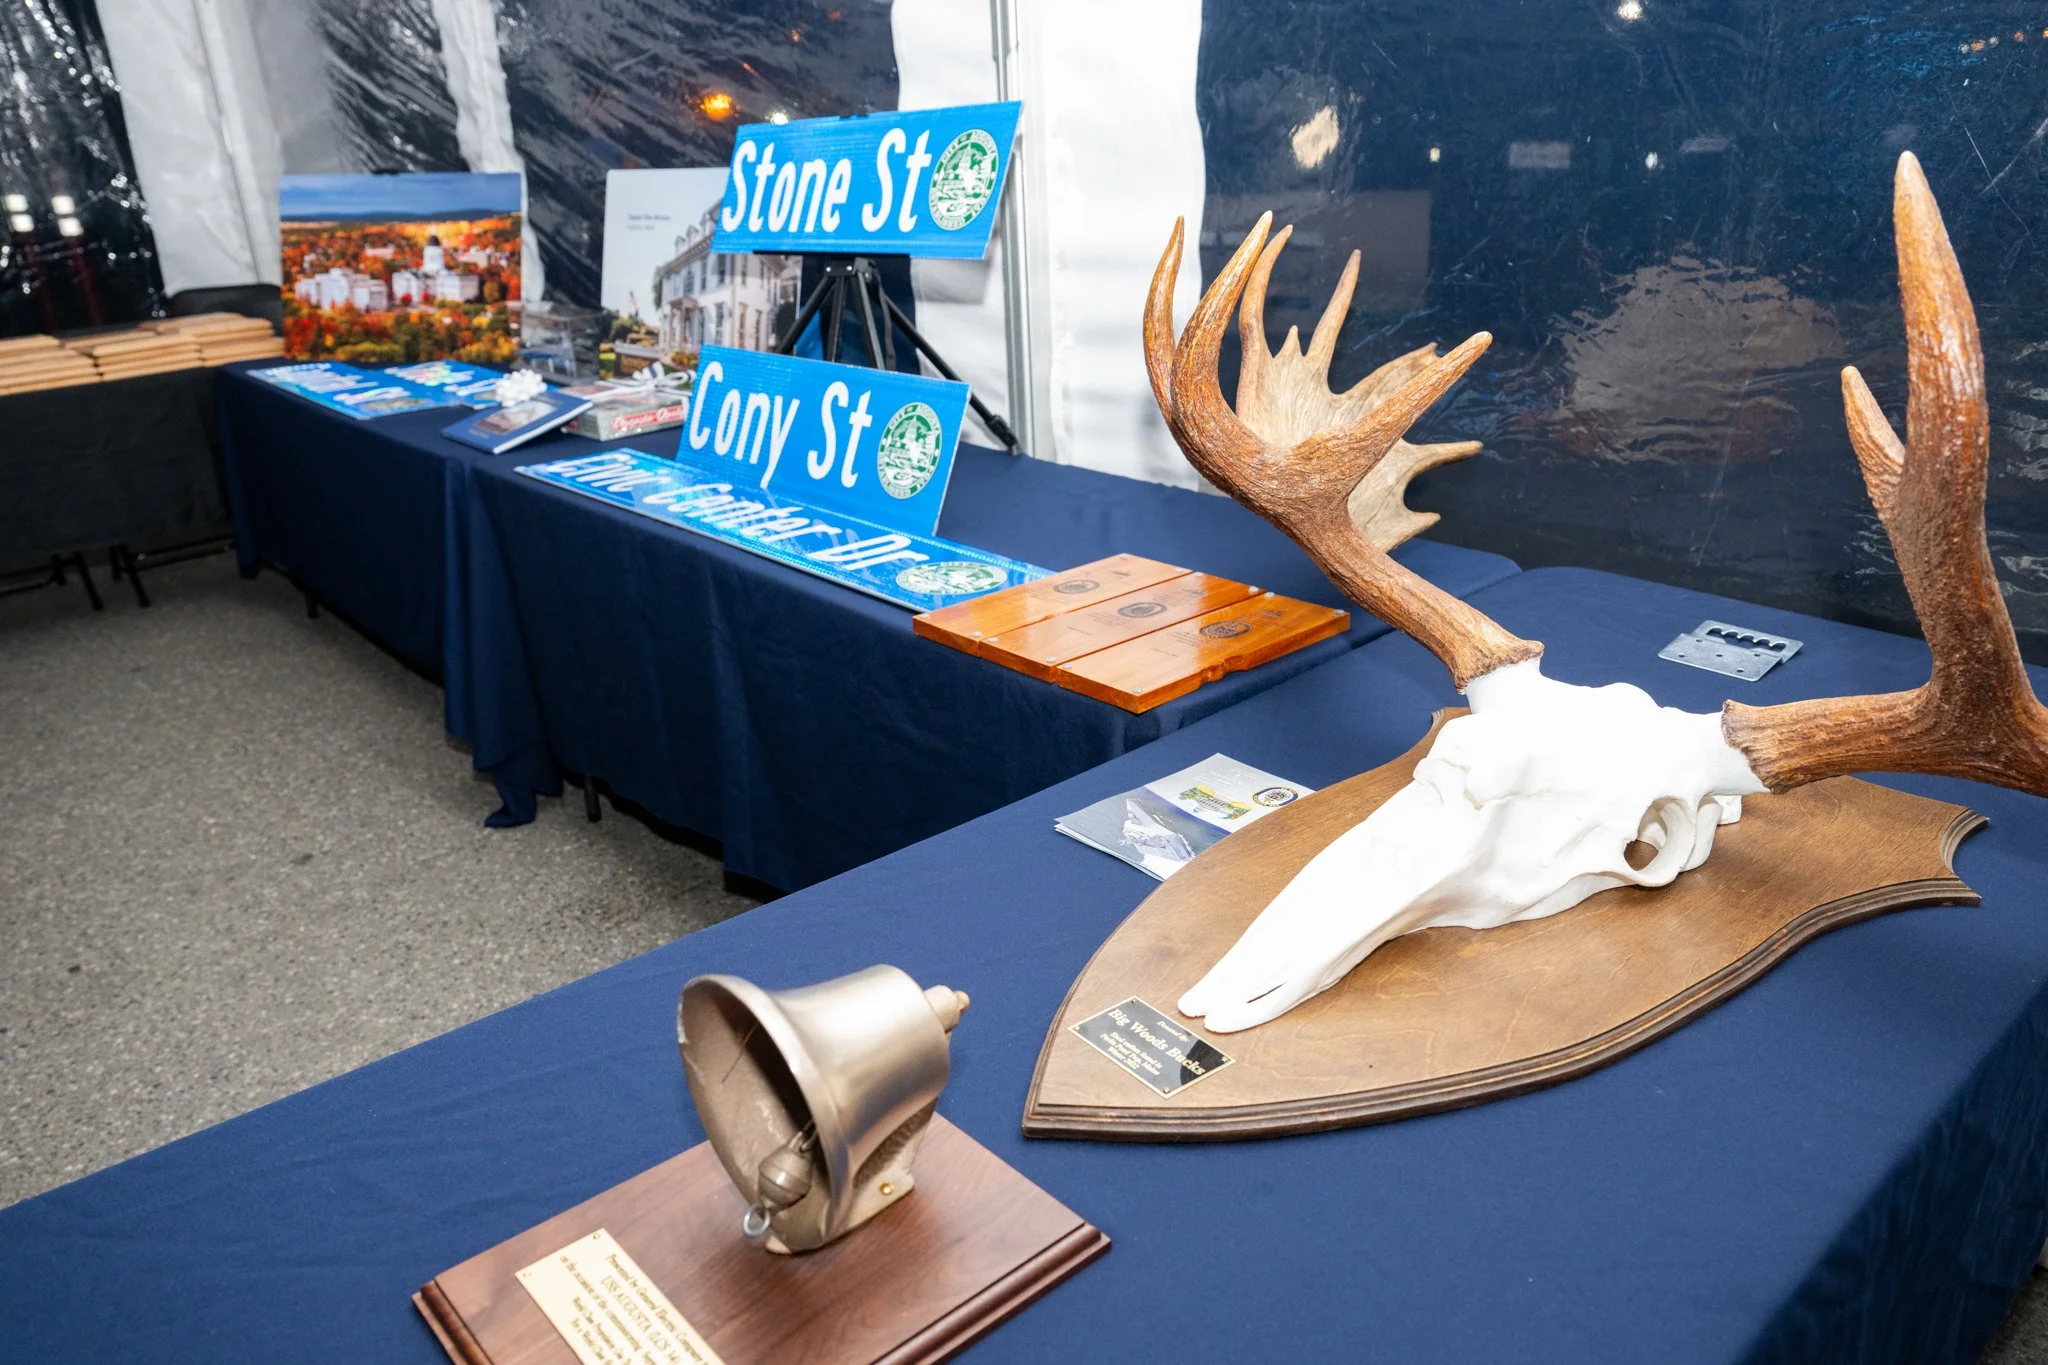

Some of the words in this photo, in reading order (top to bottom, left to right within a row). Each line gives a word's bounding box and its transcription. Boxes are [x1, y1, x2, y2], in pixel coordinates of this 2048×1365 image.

[721, 140, 852, 233] Stone
[862, 128, 932, 233] St
[688, 361, 800, 489] Cony
[807, 381, 872, 488] St
[546, 452, 673, 493] Civic
[642, 481, 843, 543] Center
[809, 534, 930, 571] Dr
[1108, 1009, 1130, 1026] Big
[1131, 1022, 1168, 1050] Woods
[1167, 1046, 1204, 1074] Bucks
